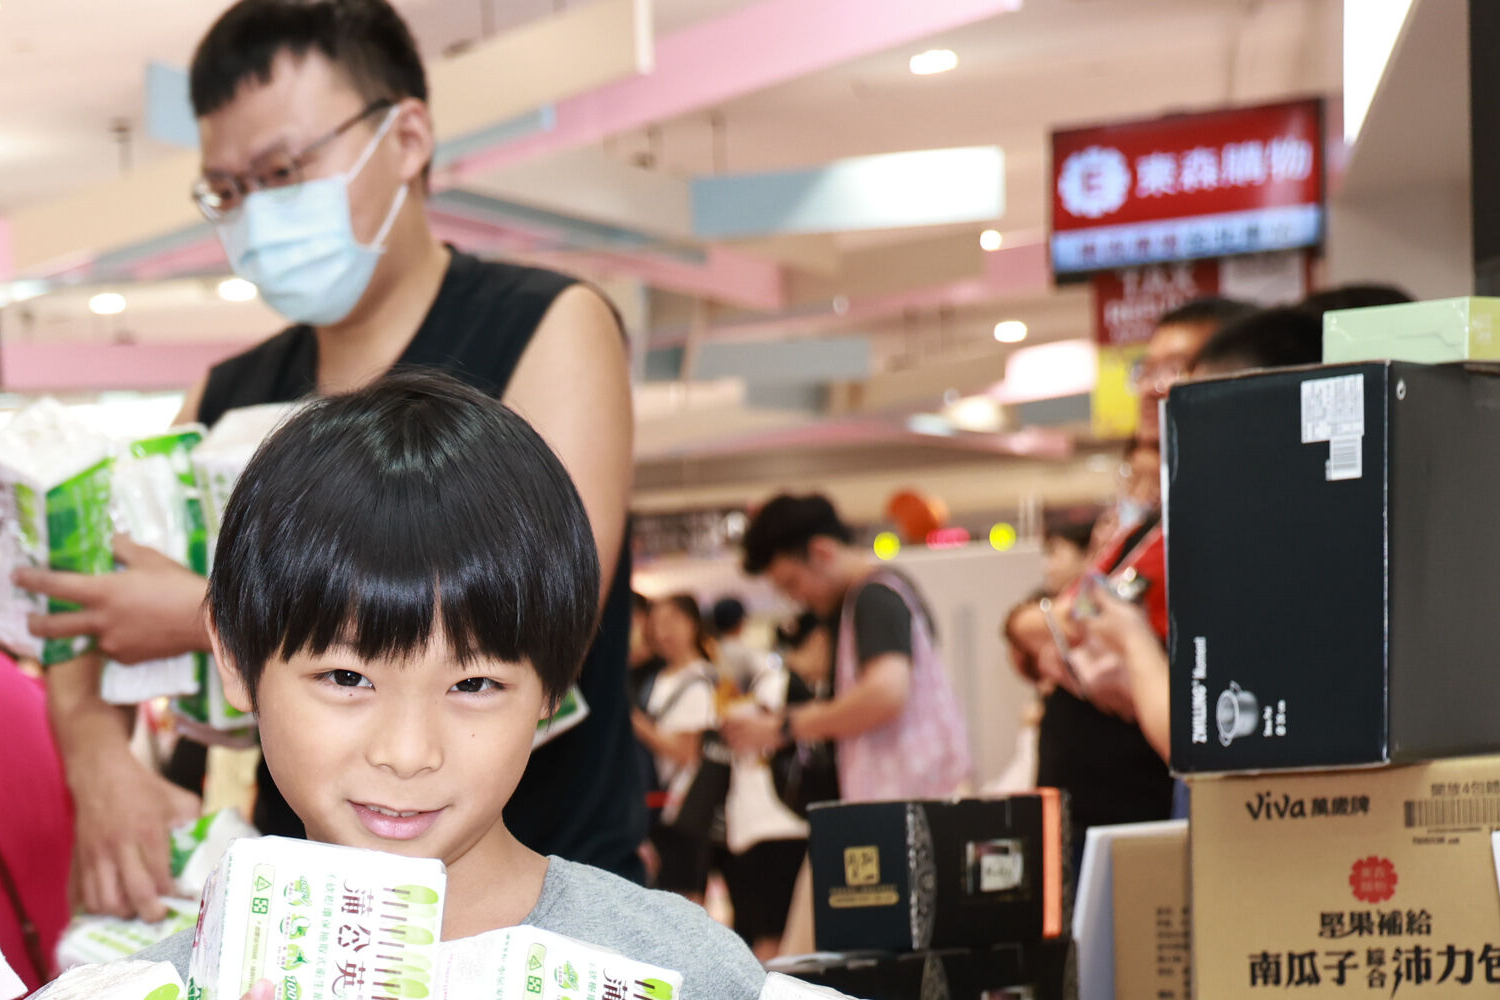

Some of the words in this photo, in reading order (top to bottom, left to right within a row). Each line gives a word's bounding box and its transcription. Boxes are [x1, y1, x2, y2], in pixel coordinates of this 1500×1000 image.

[331, 880, 374, 998] 蒲公英
[1318, 908, 1433, 939] 堅果補給
